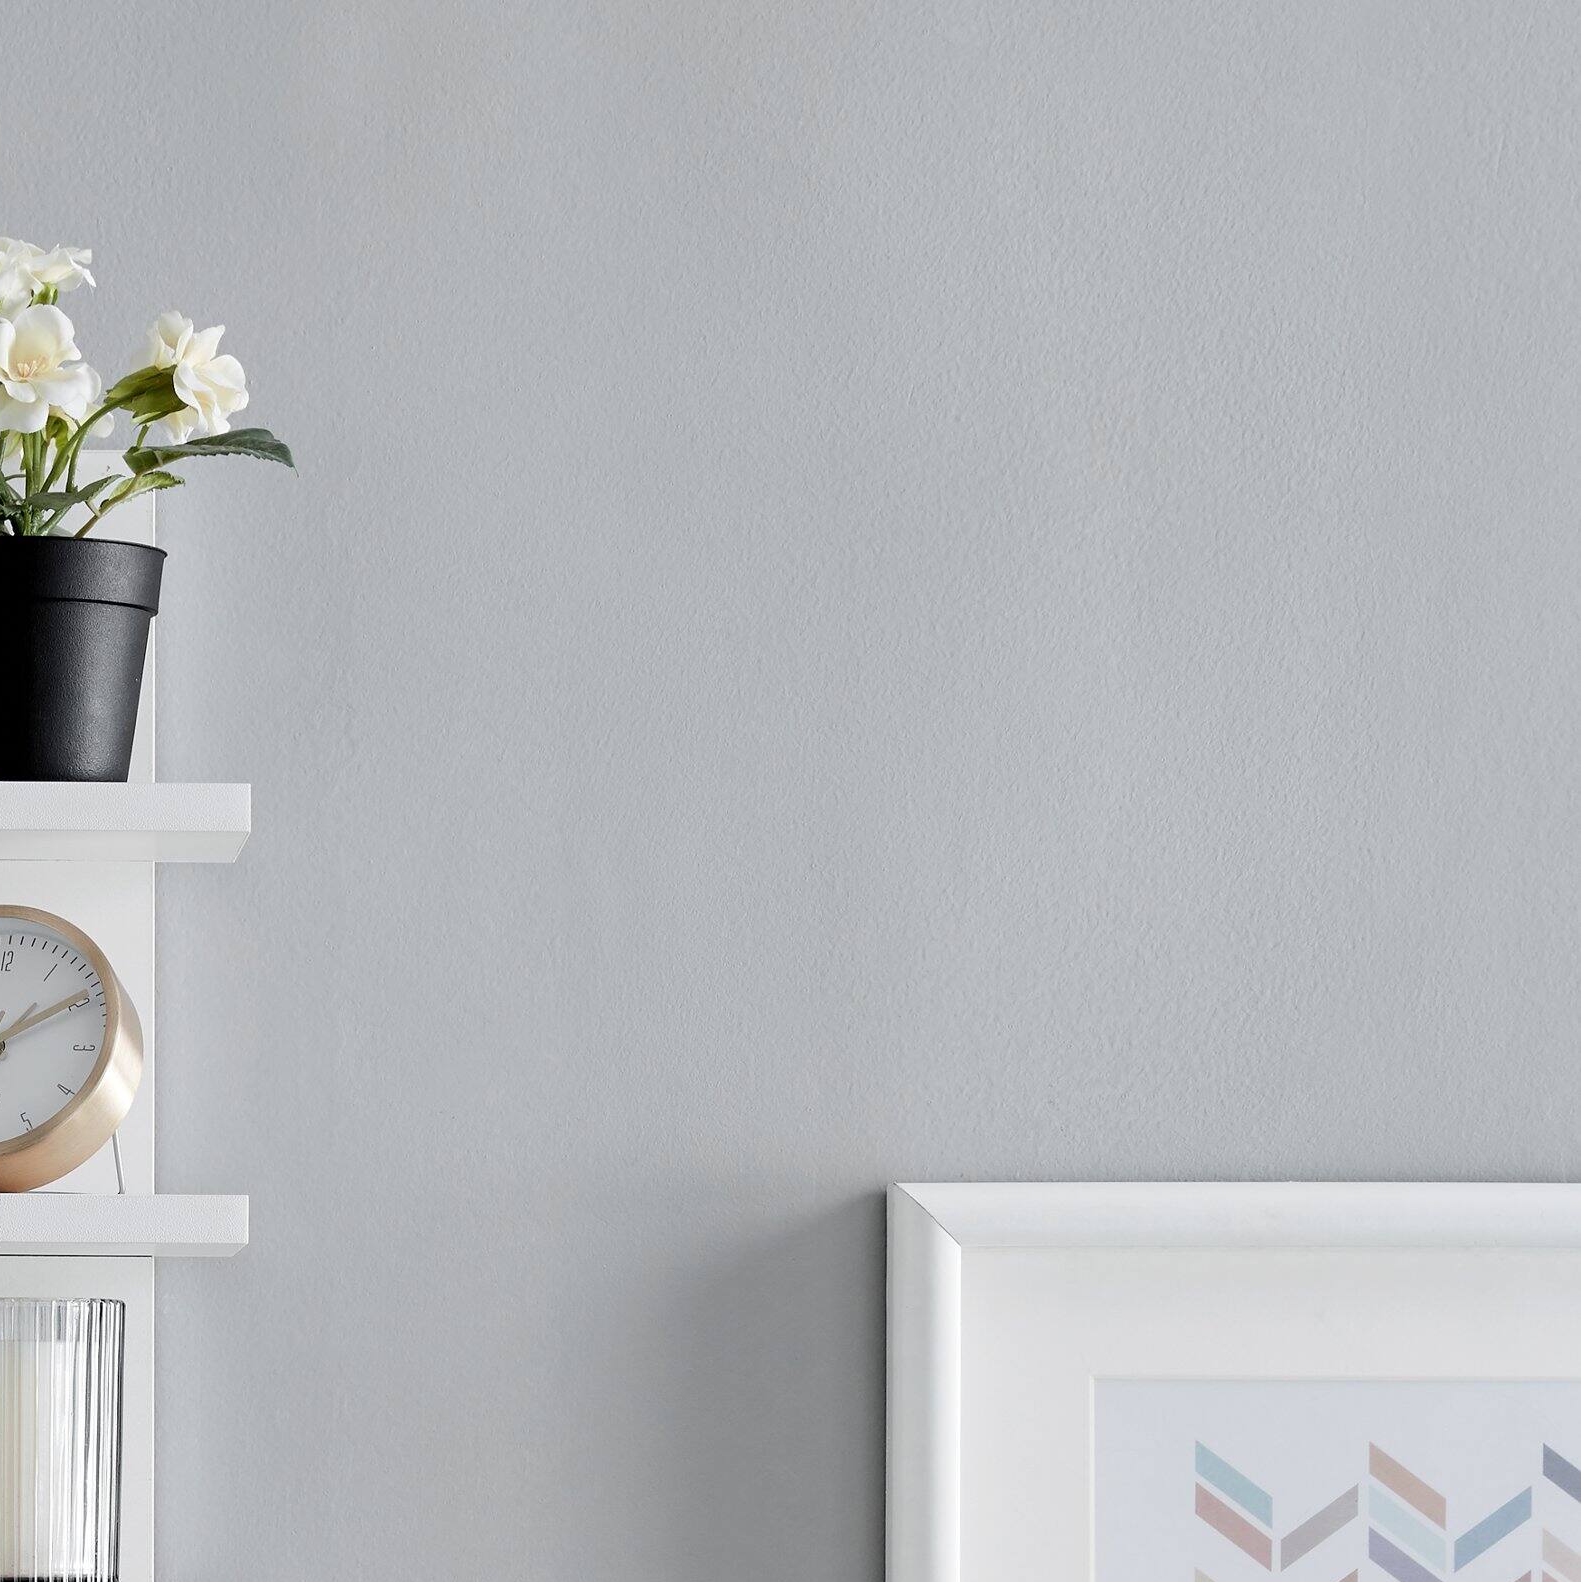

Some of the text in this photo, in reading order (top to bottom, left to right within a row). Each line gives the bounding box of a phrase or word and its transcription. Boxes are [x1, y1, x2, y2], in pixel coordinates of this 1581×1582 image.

[0, 950, 14, 972] 12
[43, 963, 58, 982] 1
[68, 997, 90, 1012] 2
[73, 1044, 95, 1052] 3
[57, 1083, 75, 1096] 4
[20, 1111, 34, 1133] 5
